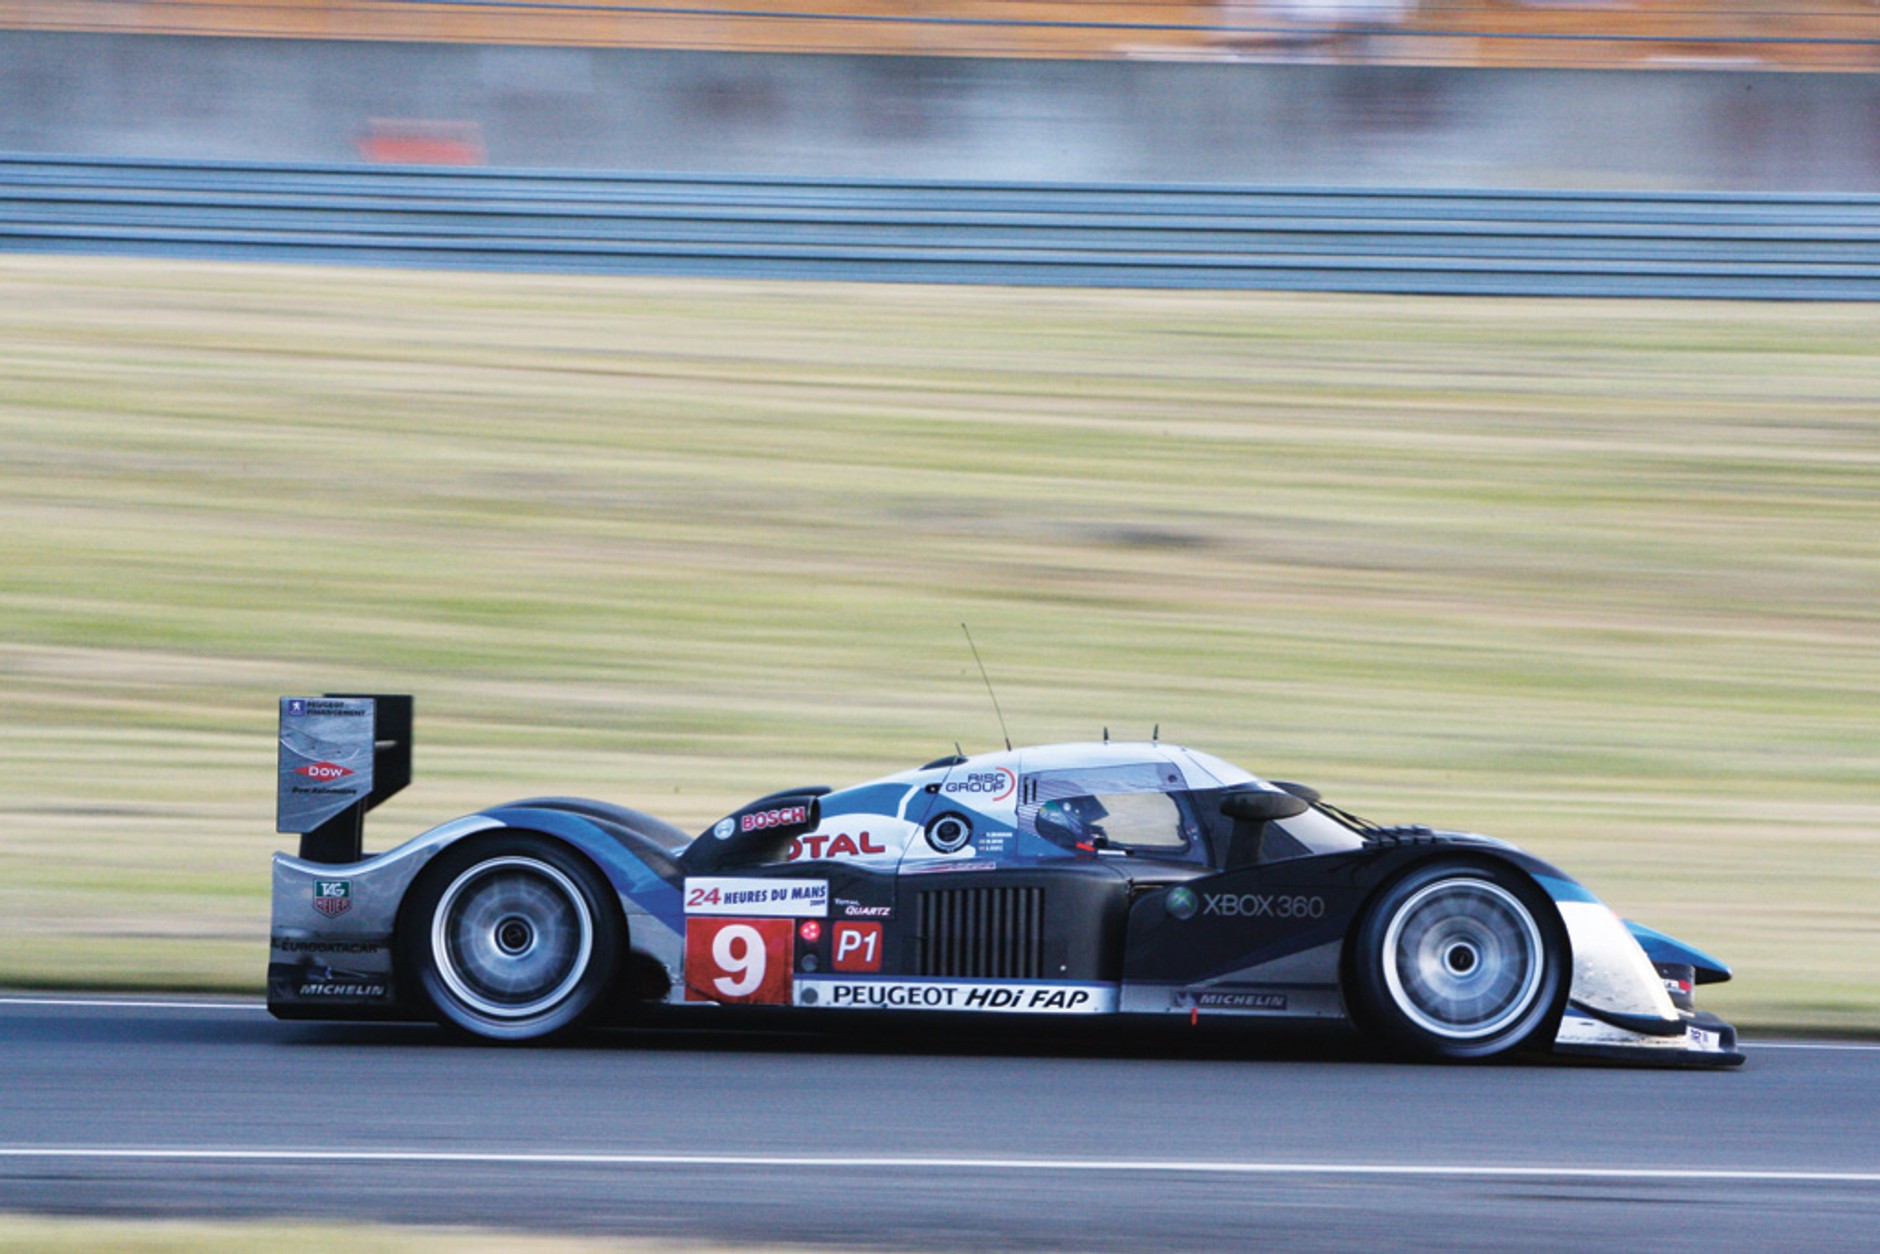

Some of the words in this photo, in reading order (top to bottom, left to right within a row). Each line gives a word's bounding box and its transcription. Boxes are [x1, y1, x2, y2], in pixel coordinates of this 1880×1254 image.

[945, 782, 1005, 793] GROUP
[968, 773, 1005, 783] RISC
[741, 806, 806, 832] BOSCH
[787, 831, 885, 861] OTAL
[321, 882, 345, 897] TAG
[687, 887, 721, 906] 24
[724, 889, 767, 905] HEURES
[771, 888, 787, 901] DU
[791, 885, 826, 900] MANS
[845, 905, 891, 915] QUARTZ
[1276, 896, 1325, 918] 360
[836, 929, 878, 963] P1
[712, 923, 767, 997] 9
[300, 984, 385, 996] MICHELIN
[832, 985, 958, 1006] PEUGEOT
[964, 988, 1023, 1007] HDi
[1028, 989, 1089, 1009] FAP
[1200, 994, 1285, 1007] MICHELIN
